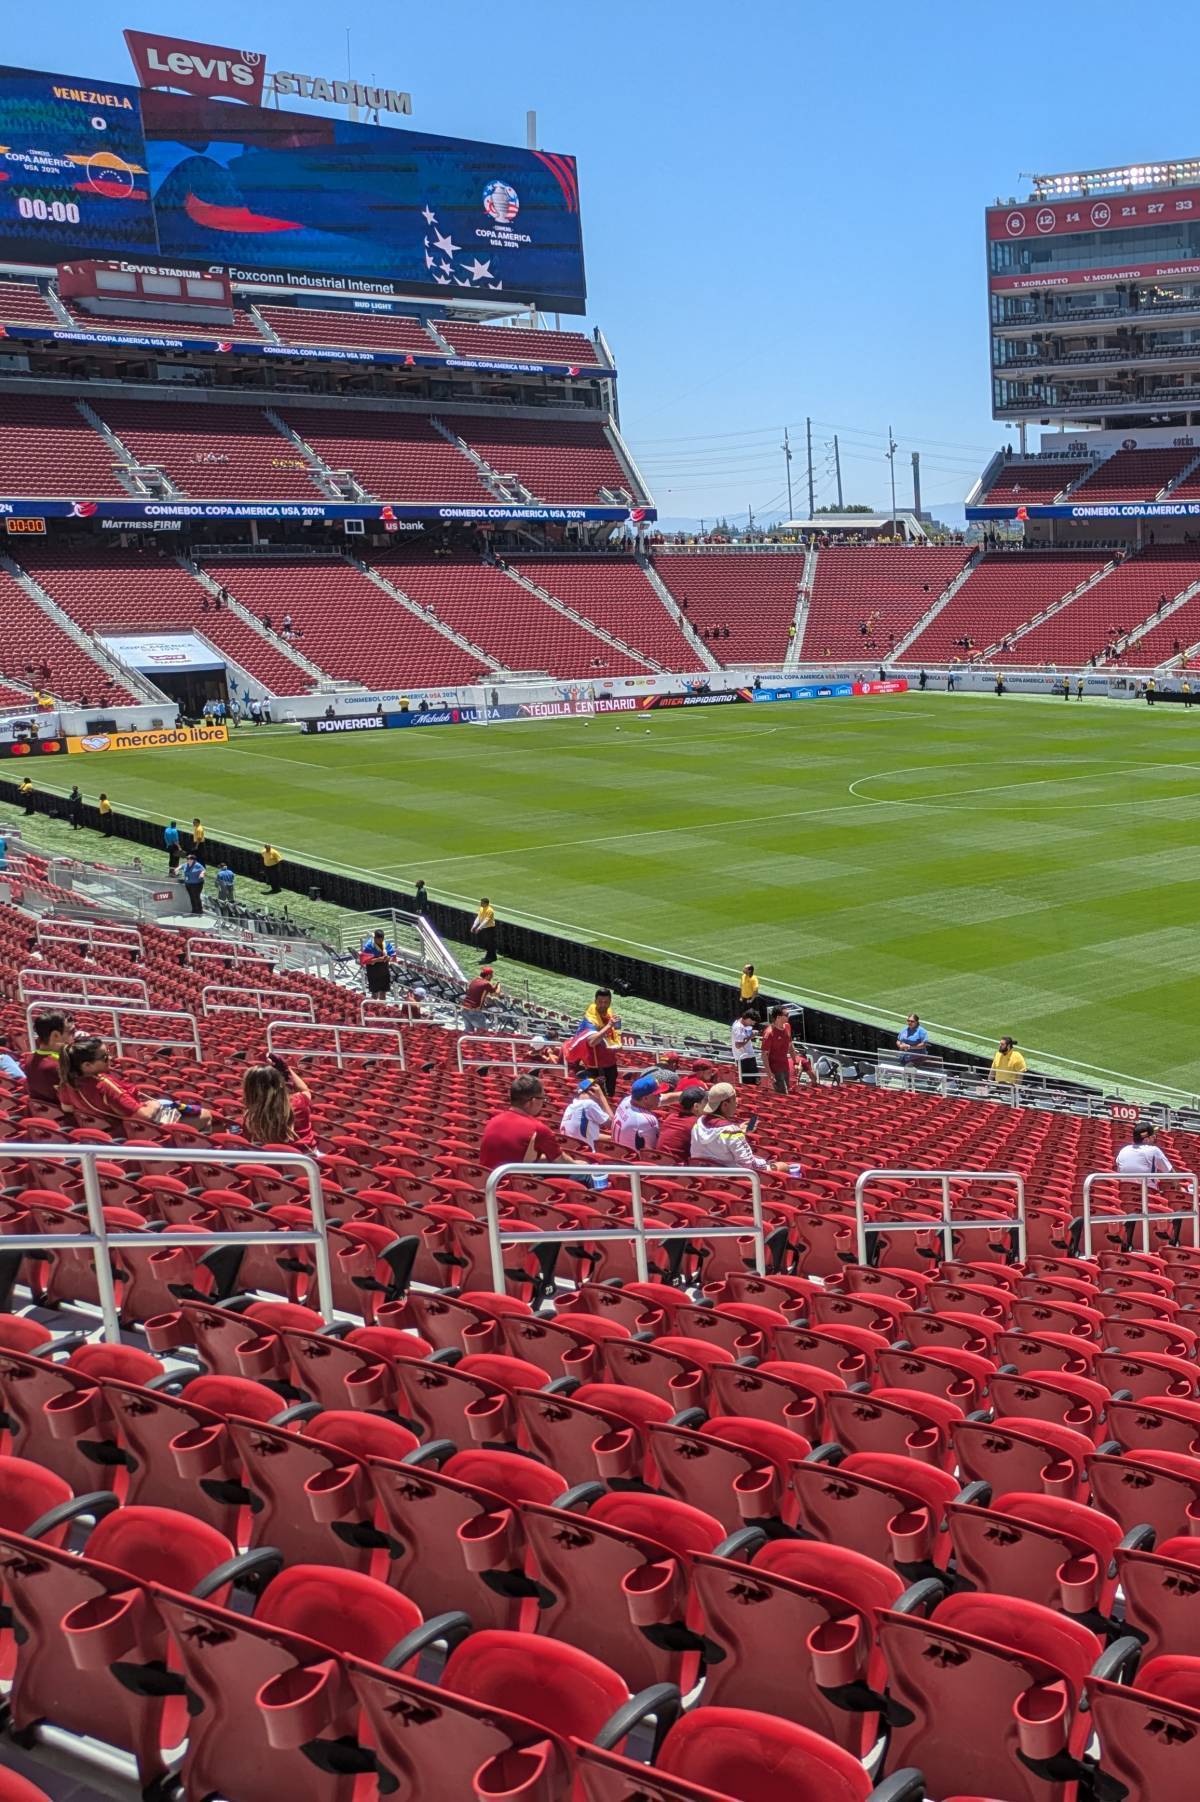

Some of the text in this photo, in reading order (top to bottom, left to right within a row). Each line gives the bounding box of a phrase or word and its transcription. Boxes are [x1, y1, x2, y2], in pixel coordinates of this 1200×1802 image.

[52, 86, 133, 111] VENEZUELA
[273, 71, 413, 115] STADIUM
[91, 116, 107, 131] 0
[5, 152, 32, 163] COPA
[33, 155, 76, 169] AMERICA
[18, 197, 80, 224] 00:00
[1121, 206, 1137, 217] 21
[1147, 203, 1164, 214] 27
[1176, 200, 1193, 211] 33
[1038, 216, 1053, 225] 12
[1066, 213, 1080, 222] 14
[1093, 210, 1108, 220] 16
[1011, 219, 1020, 228] 8
[475, 229, 532, 243] COPA AMERICA
[159, 267, 201, 279] STADIUM
[1092, 271, 1141, 282] MORABITO
[228, 267, 284, 285] Foxconn
[286, 272, 346, 289] Industrial
[348, 277, 395, 294] Internet
[1021, 277, 1069, 288] MORABITO
[354, 301, 392, 311] BUD LIGHT
[53, 331, 182, 348] CONMEBOL COPA AMERICA USA 2024
[263, 346, 299, 356] CONMEBOL
[300, 349, 317, 357] COPA
[318, 350, 347, 359] AMERICA
[446, 359, 478, 368] CONMEBOL
[478, 361, 494, 369] COPA
[494, 362, 519, 371] AMERICA
[144, 506, 325, 516] CONMEBOL COPA AMERICA USA 2024
[439, 508, 586, 519] CONMEBOL COPA AMERICA USA 2024
[1072, 507, 1121, 517] CONMEBOL
[1121, 506, 1146, 515] COPA
[1146, 505, 1187, 515] AMERICA
[8, 519, 44, 532] 00:00
[399, 521, 424, 531] bank
[344, 696, 382, 704] CONMEBOL
[529, 698, 636, 716] TEQUILA CENTENARIO
[460, 709, 501, 721] ULTRA
[316, 717, 384, 732] POWERADE
[116, 728, 225, 748] mercado libre
[1113, 1106, 1137, 1120] 109
